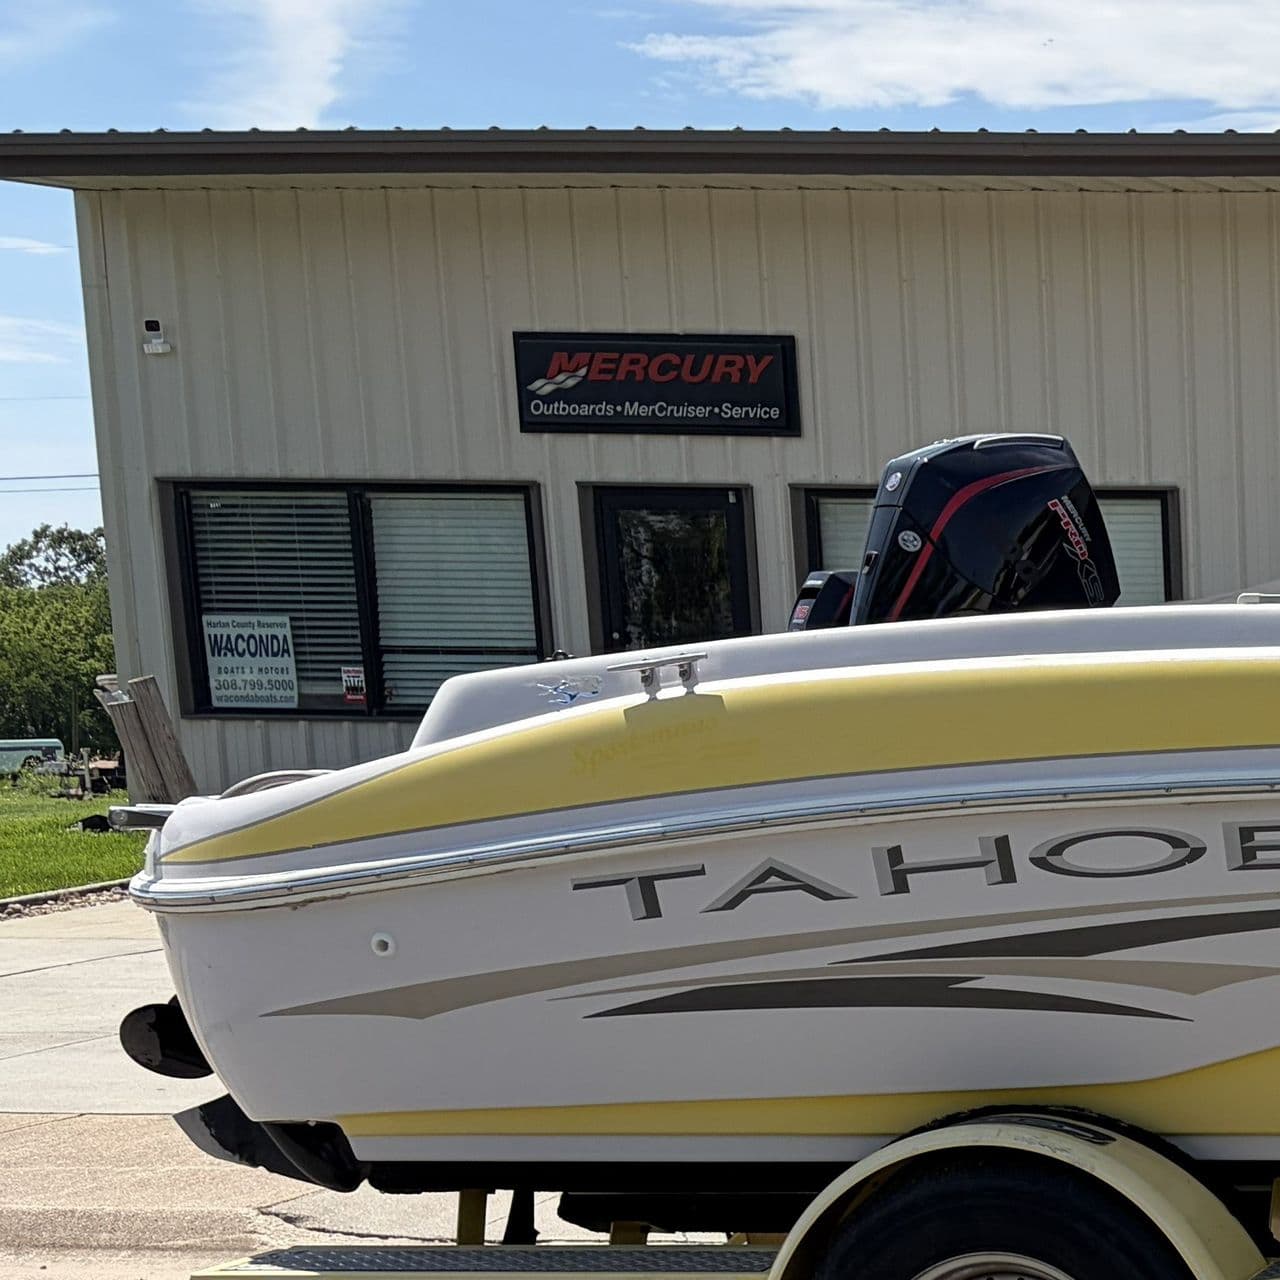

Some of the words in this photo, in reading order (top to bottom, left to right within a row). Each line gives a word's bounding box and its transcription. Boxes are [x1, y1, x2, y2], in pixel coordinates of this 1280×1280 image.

[546, 351, 774, 384] MERCURY
[720, 403, 780, 419] Service
[206, 620, 230, 628] Harlan
[231, 620, 255, 630] County
[256, 620, 288, 629] Reservoir
[208, 633, 291, 658] WACONDA
[217, 666, 246, 675] BOATS
[257, 666, 290, 675] MOTORS
[215, 679, 295, 691] 308.799.5000
[215, 693, 296, 703] wacondaboats.com
